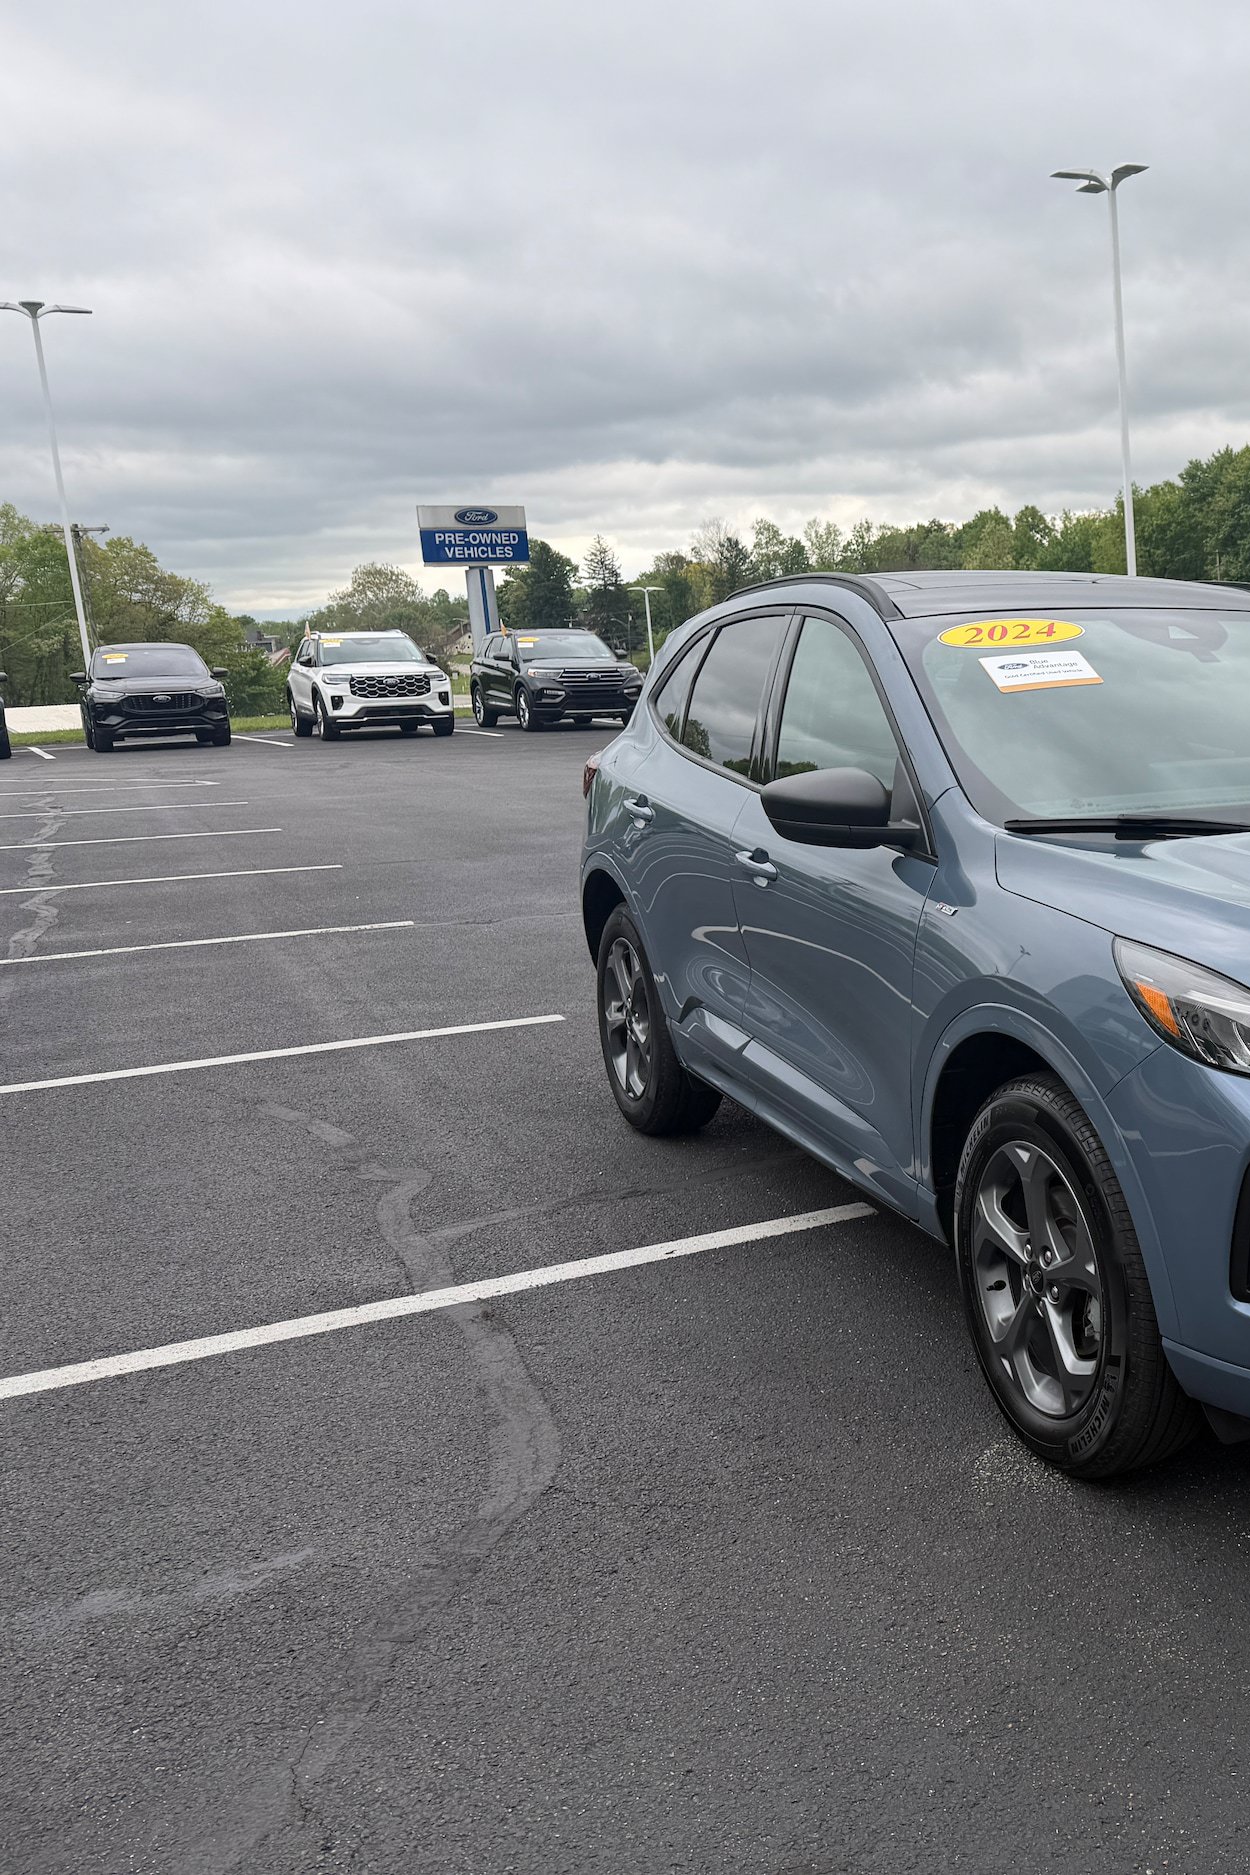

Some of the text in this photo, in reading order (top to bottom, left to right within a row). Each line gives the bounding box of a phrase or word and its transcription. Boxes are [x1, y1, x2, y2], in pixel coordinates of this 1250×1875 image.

[464, 511, 489, 521] Ford
[435, 533, 519, 545] PRE-OWNED
[445, 546, 514, 558] VEHICLES
[964, 622, 1057, 645] 2024
[960, 1112, 991, 1179] MICHELIN
[1070, 1393, 1111, 1455] MICHELIN
